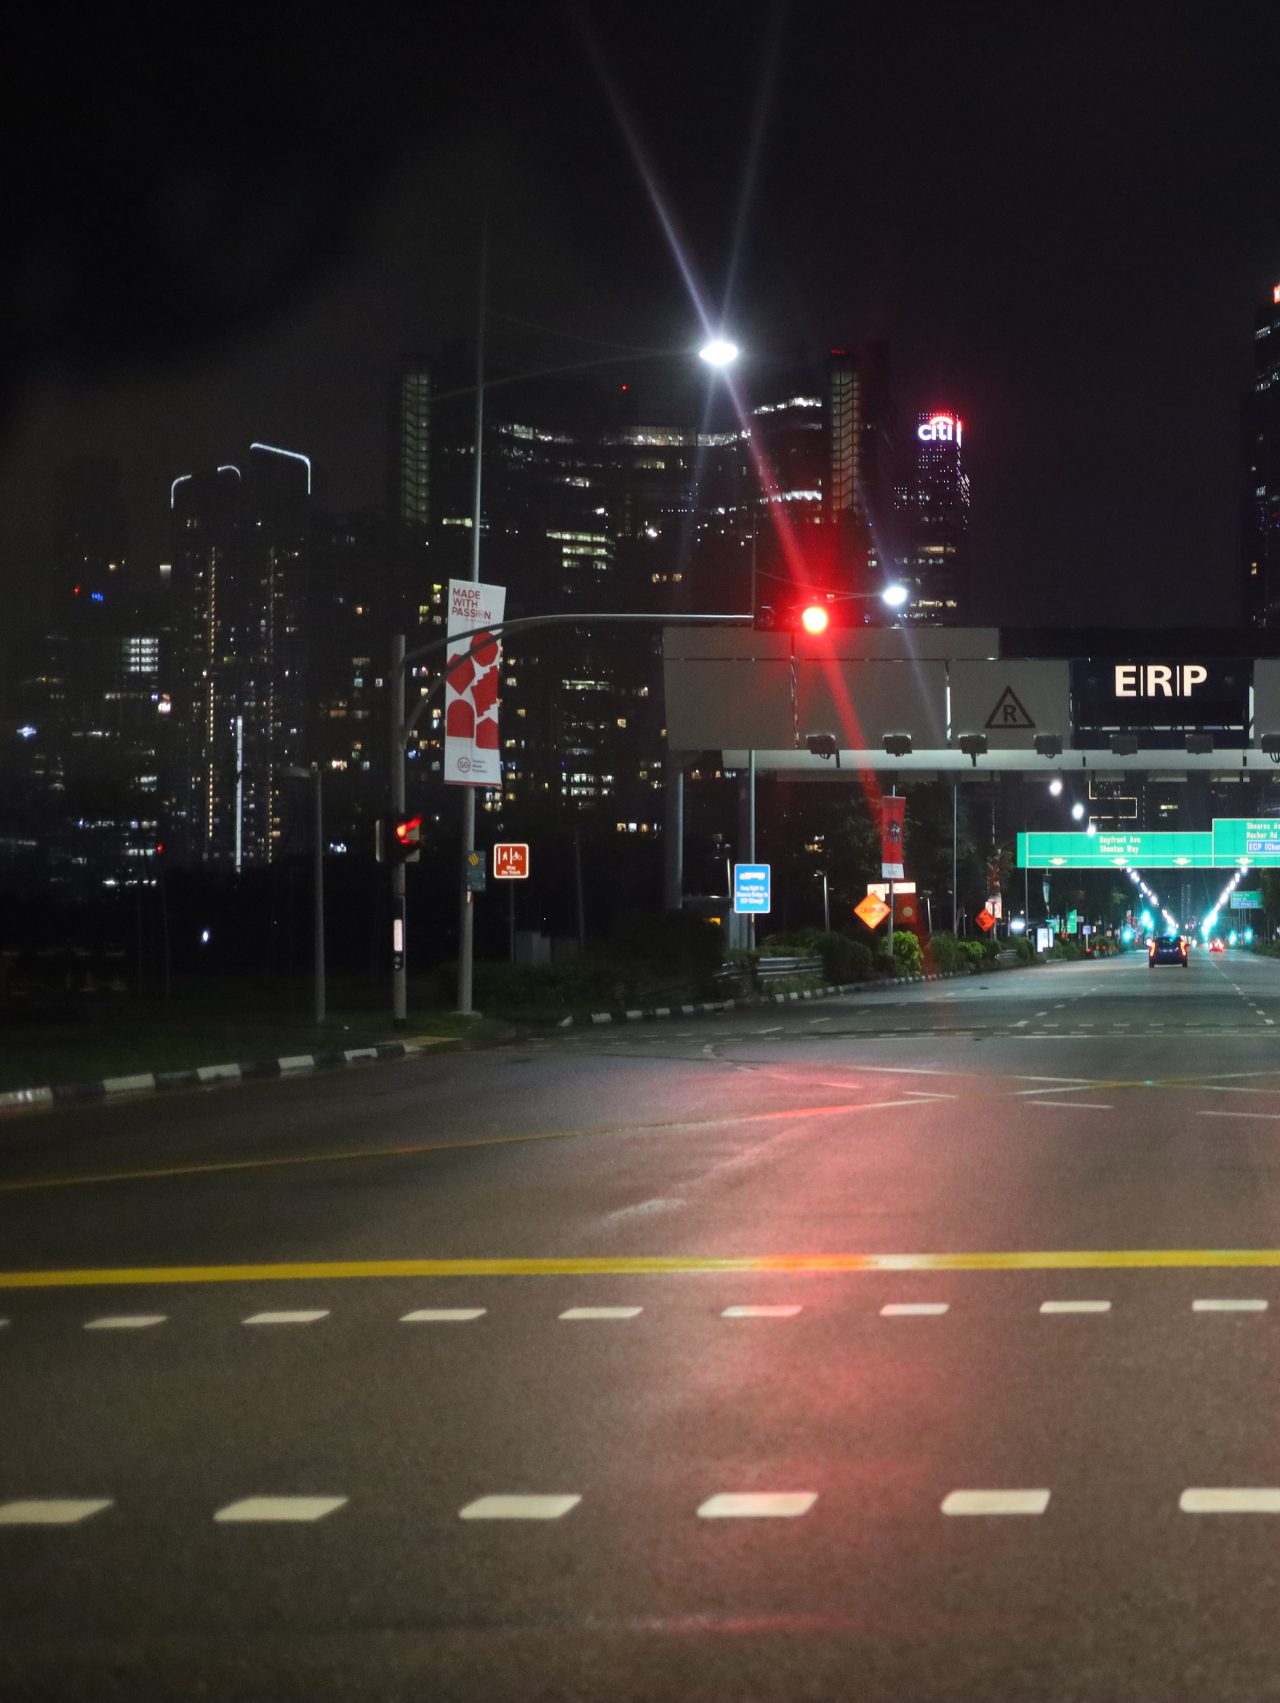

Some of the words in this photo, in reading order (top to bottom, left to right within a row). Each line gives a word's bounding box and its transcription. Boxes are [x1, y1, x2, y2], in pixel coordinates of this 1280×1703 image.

[918, 417, 953, 441] citi
[453, 588, 481, 600] MADE
[453, 598, 478, 608] WITH
[1115, 665, 1208, 697] ERP
[1003, 704, 1017, 722] R
